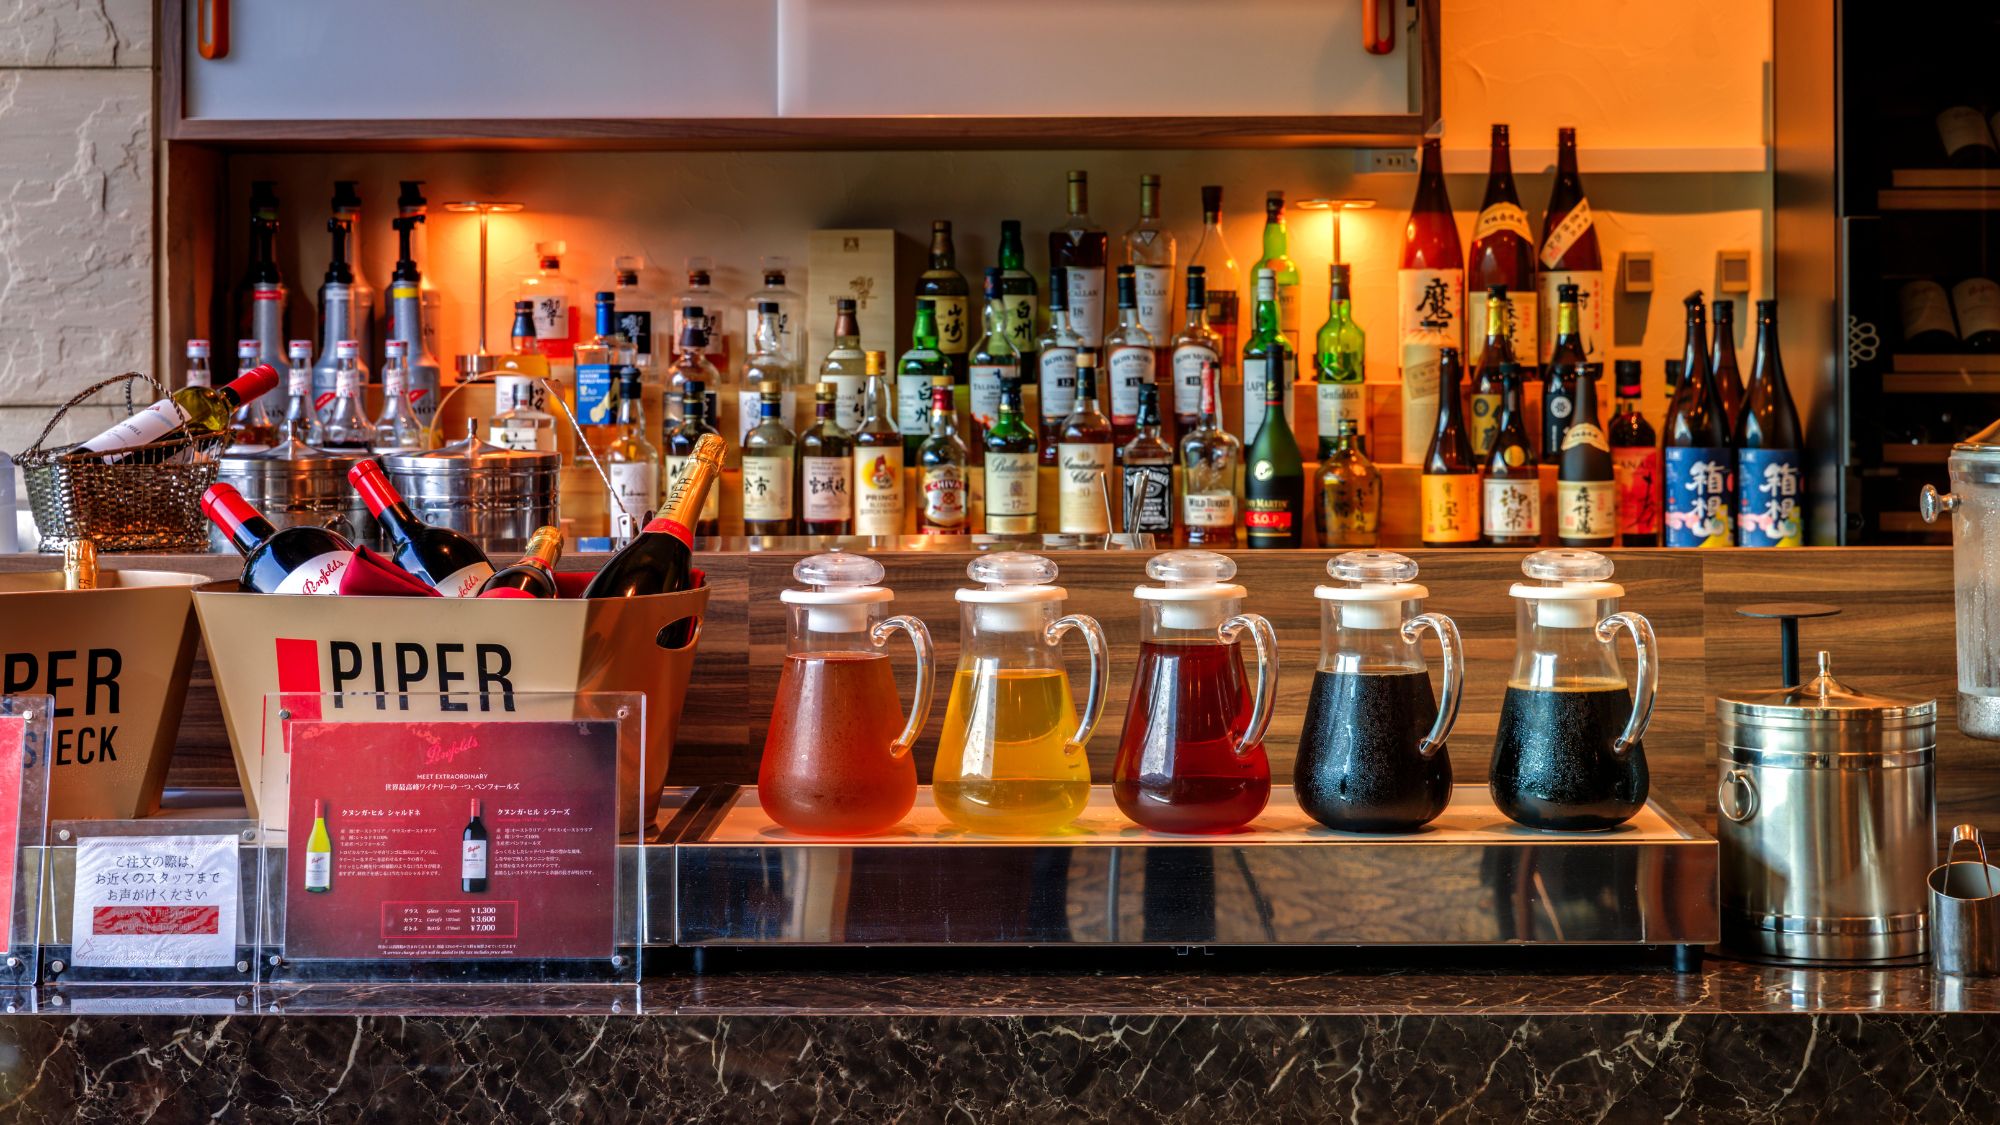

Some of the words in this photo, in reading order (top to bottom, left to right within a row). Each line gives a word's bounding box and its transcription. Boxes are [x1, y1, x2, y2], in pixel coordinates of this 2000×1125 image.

[663, 478, 694, 510] PIPER
[303, 559, 345, 595] Penfolds
[330, 641, 516, 712] PIPER
[388, 809, 421, 817] シャルドネ
[543, 808, 571, 816] シラーズ
[116, 855, 195, 869] ご注文の際は、
[96, 872, 220, 885] お近くのスタッフまで
[108, 889, 207, 901] お声がけください
[471, 906, 496, 914] ¥1,300
[470, 924, 496, 932] ¥7,000
